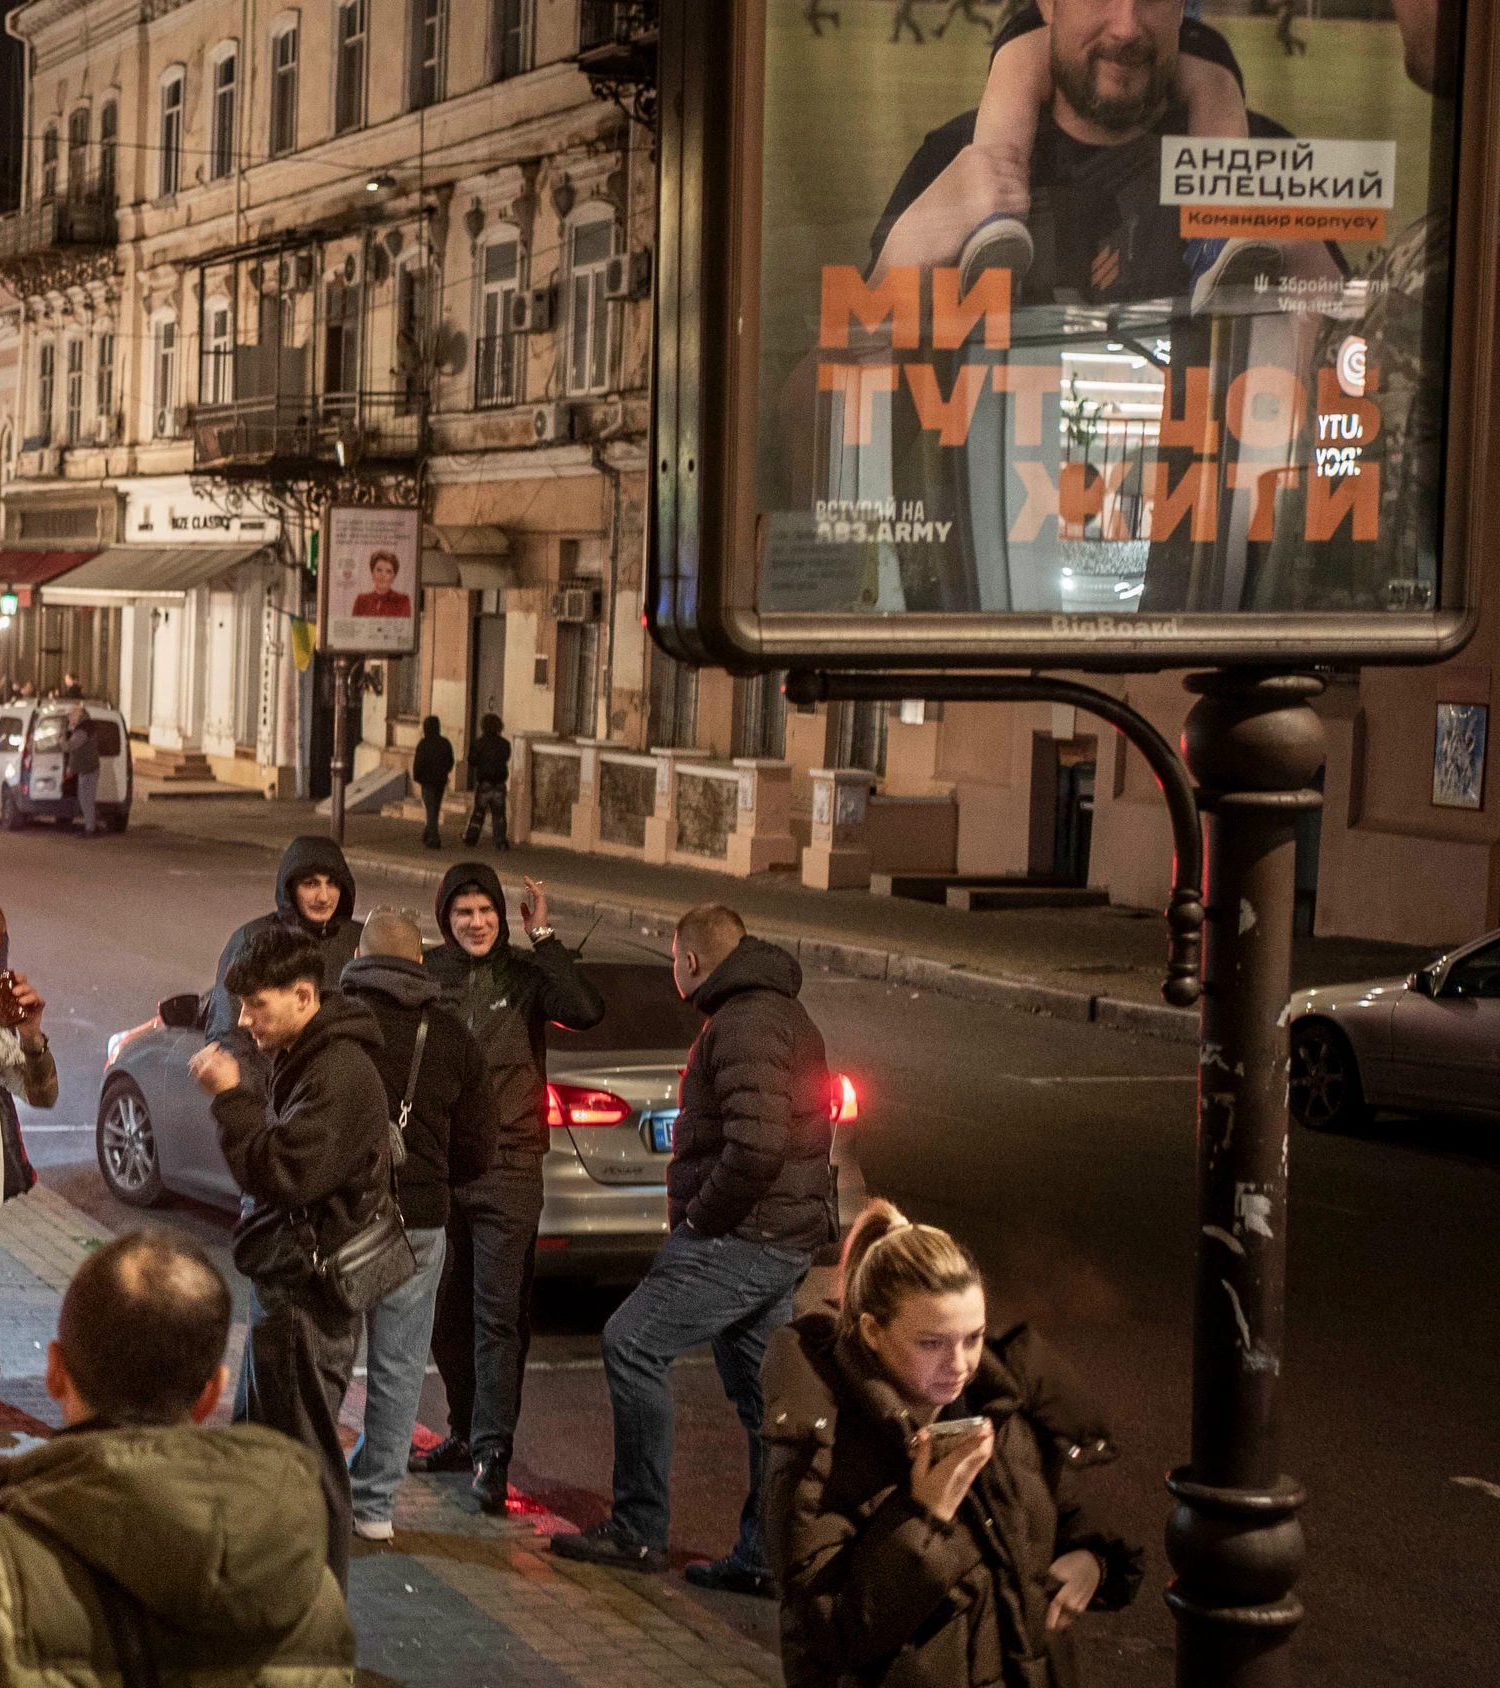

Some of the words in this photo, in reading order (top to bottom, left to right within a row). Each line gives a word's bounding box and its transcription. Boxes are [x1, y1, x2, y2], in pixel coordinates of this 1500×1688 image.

[1174, 142, 1314, 173] АНДРІЙ
[1174, 170, 1383, 201] БІЛЕЦЬКИЙ
[1188, 211, 1291, 228] Командир
[1294, 214, 1379, 231] корпусу
[1278, 275, 1344, 294] Збройні
[819, 265, 1013, 350] МИ
[818, 363, 1063, 447] ТУТ
[815, 496, 897, 522] ВСТУПАЙ
[902, 500, 925, 522] НА
[1007, 461, 1381, 543] ЖИТИ
[1051, 614, 1180, 641] BigBoard
